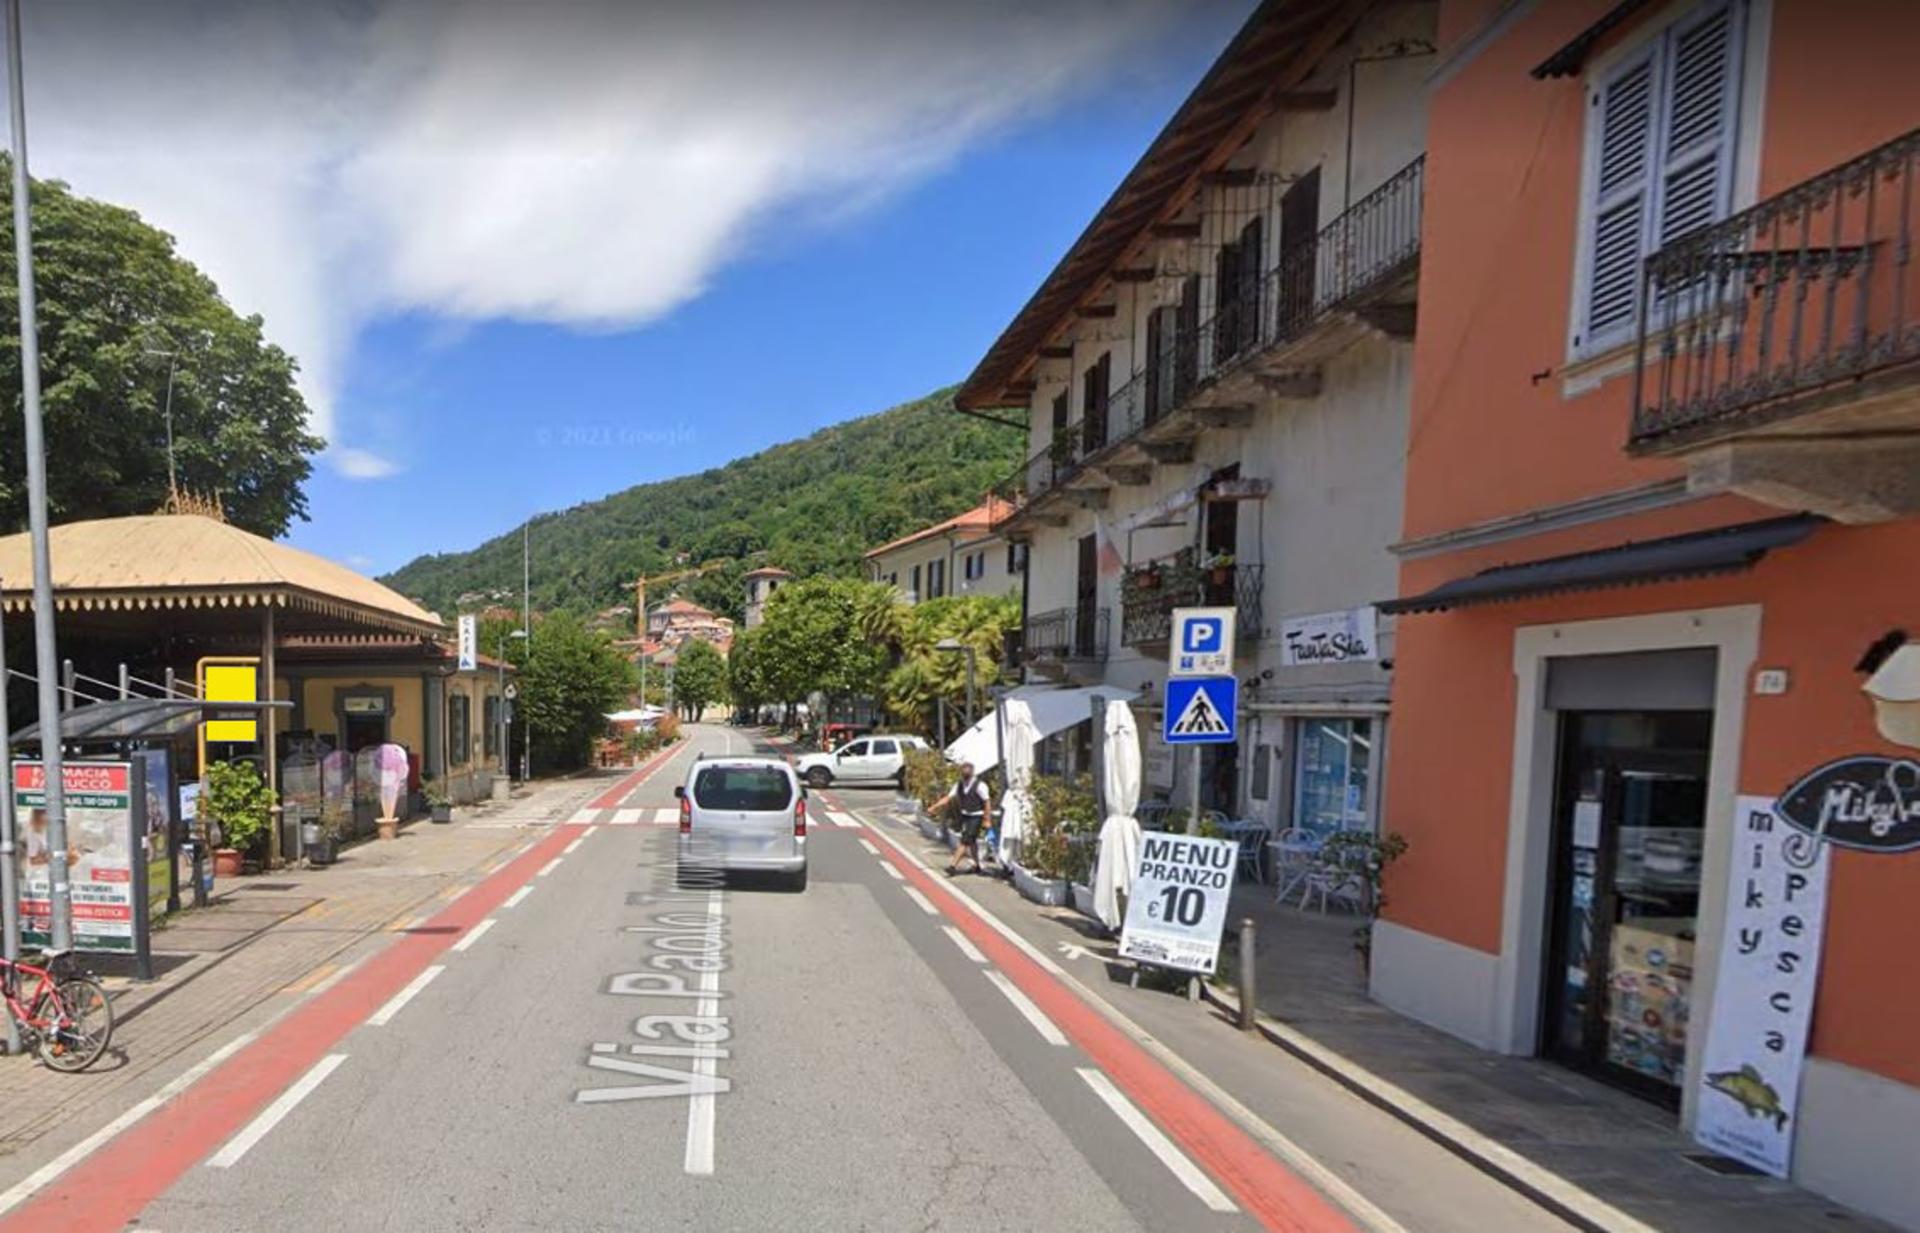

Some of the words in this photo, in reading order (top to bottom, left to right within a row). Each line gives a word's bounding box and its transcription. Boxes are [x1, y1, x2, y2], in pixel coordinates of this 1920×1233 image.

[1190, 623, 1214, 649] P
[1139, 862, 1228, 889] PRANZO
[1738, 810, 1773, 954] miky
